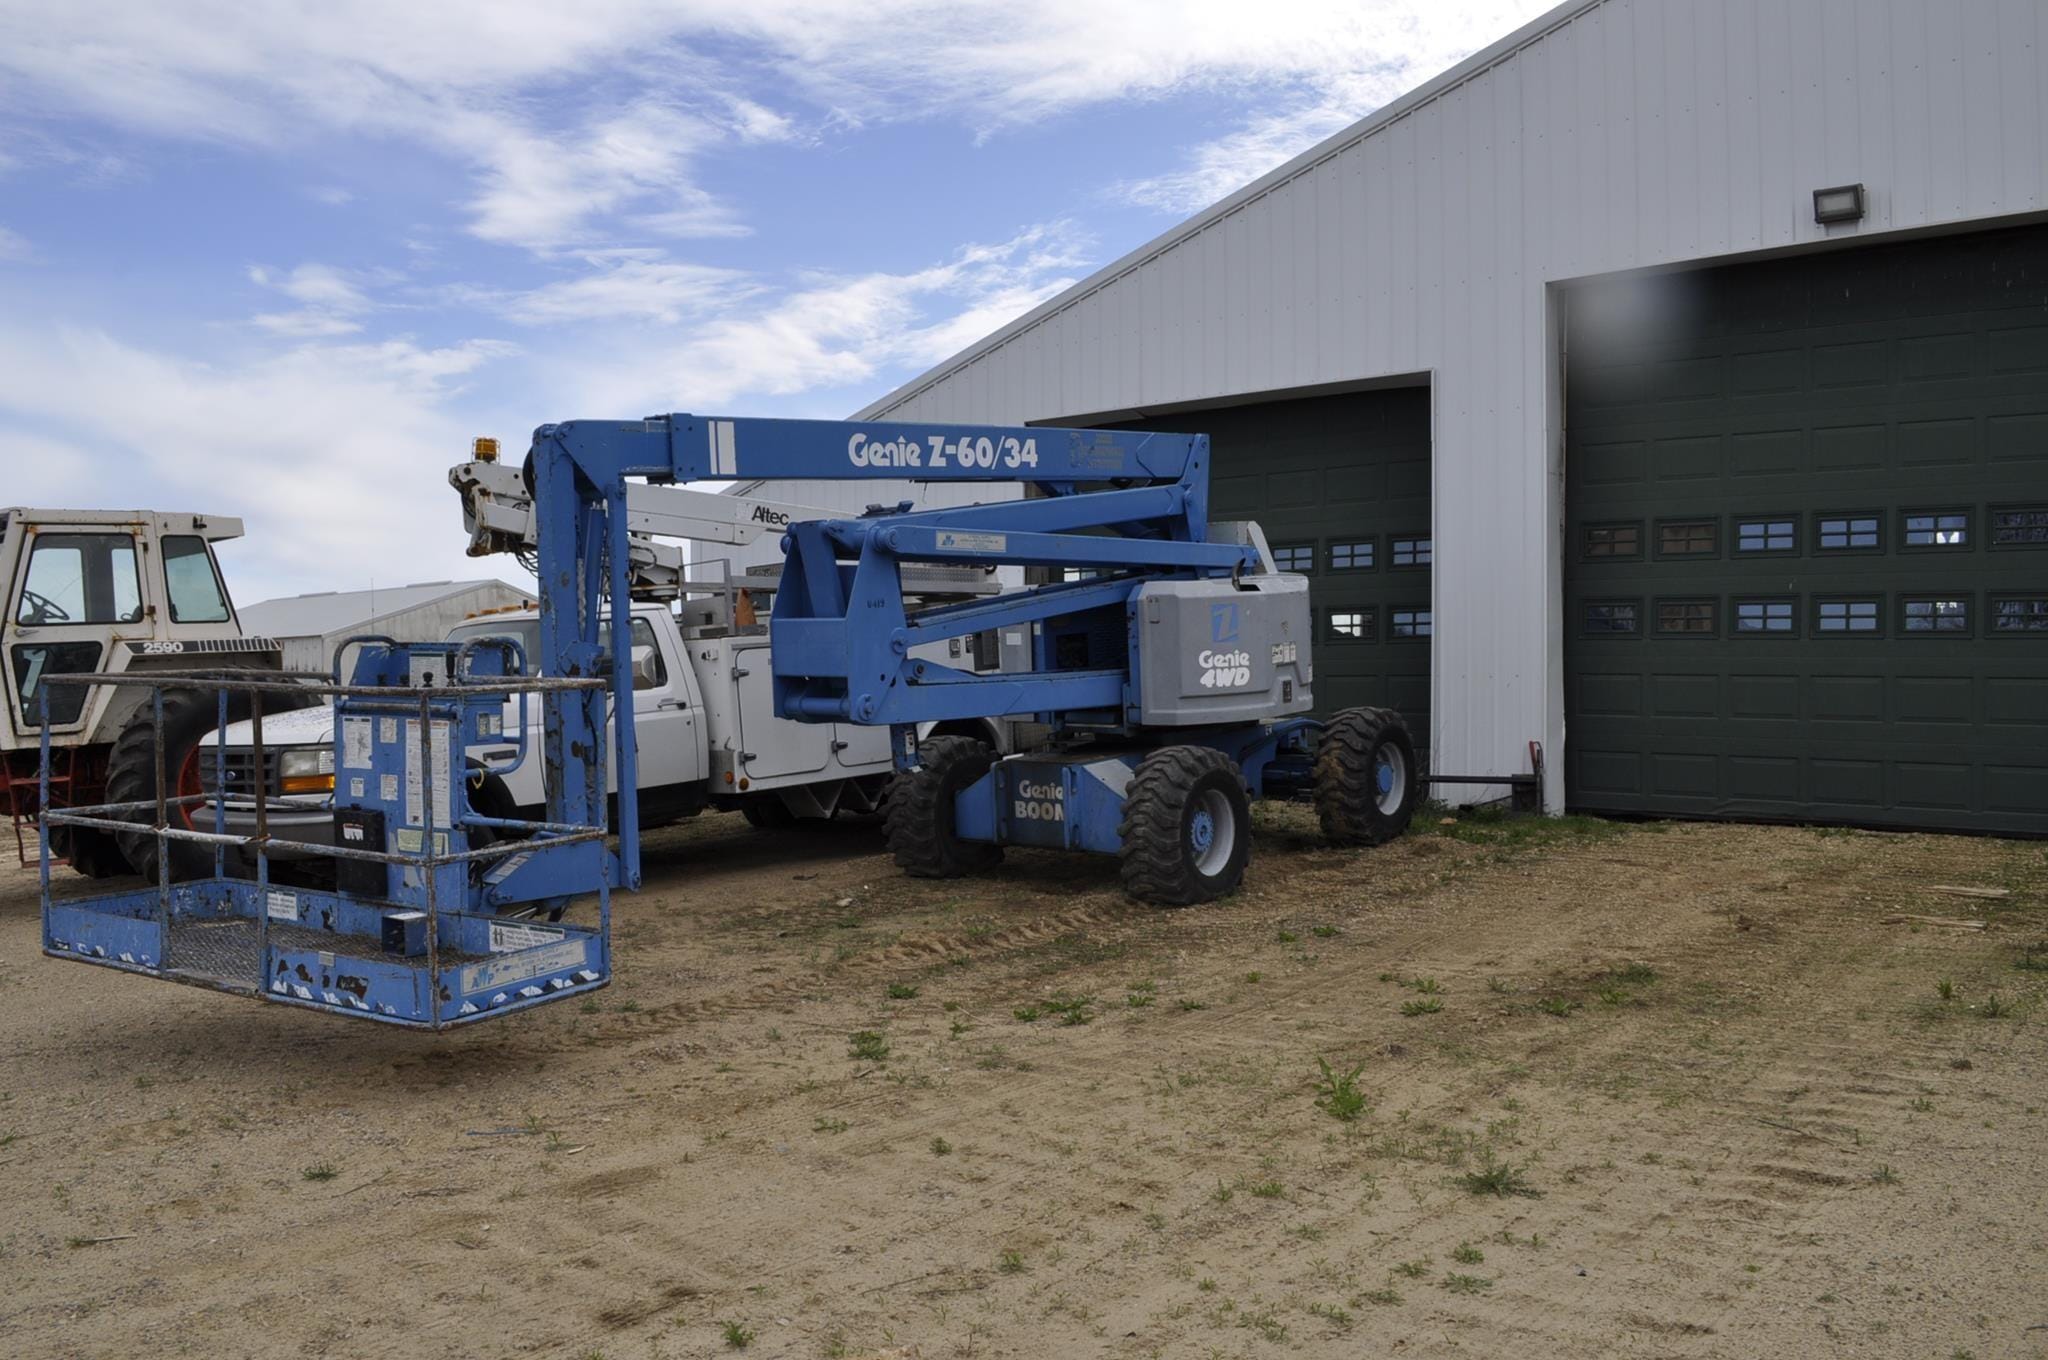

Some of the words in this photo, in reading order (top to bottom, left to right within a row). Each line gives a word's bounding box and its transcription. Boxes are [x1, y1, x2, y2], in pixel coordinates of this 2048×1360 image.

[848, 433, 921, 467] Genie
[928, 436, 1039, 470] Z-60/34
[752, 505, 789, 526] Altec
[143, 642, 184, 653] 2590
[1198, 650, 1250, 668] Genie
[1200, 667, 1250, 688] 4WD
[1019, 779, 1063, 800] Genie
